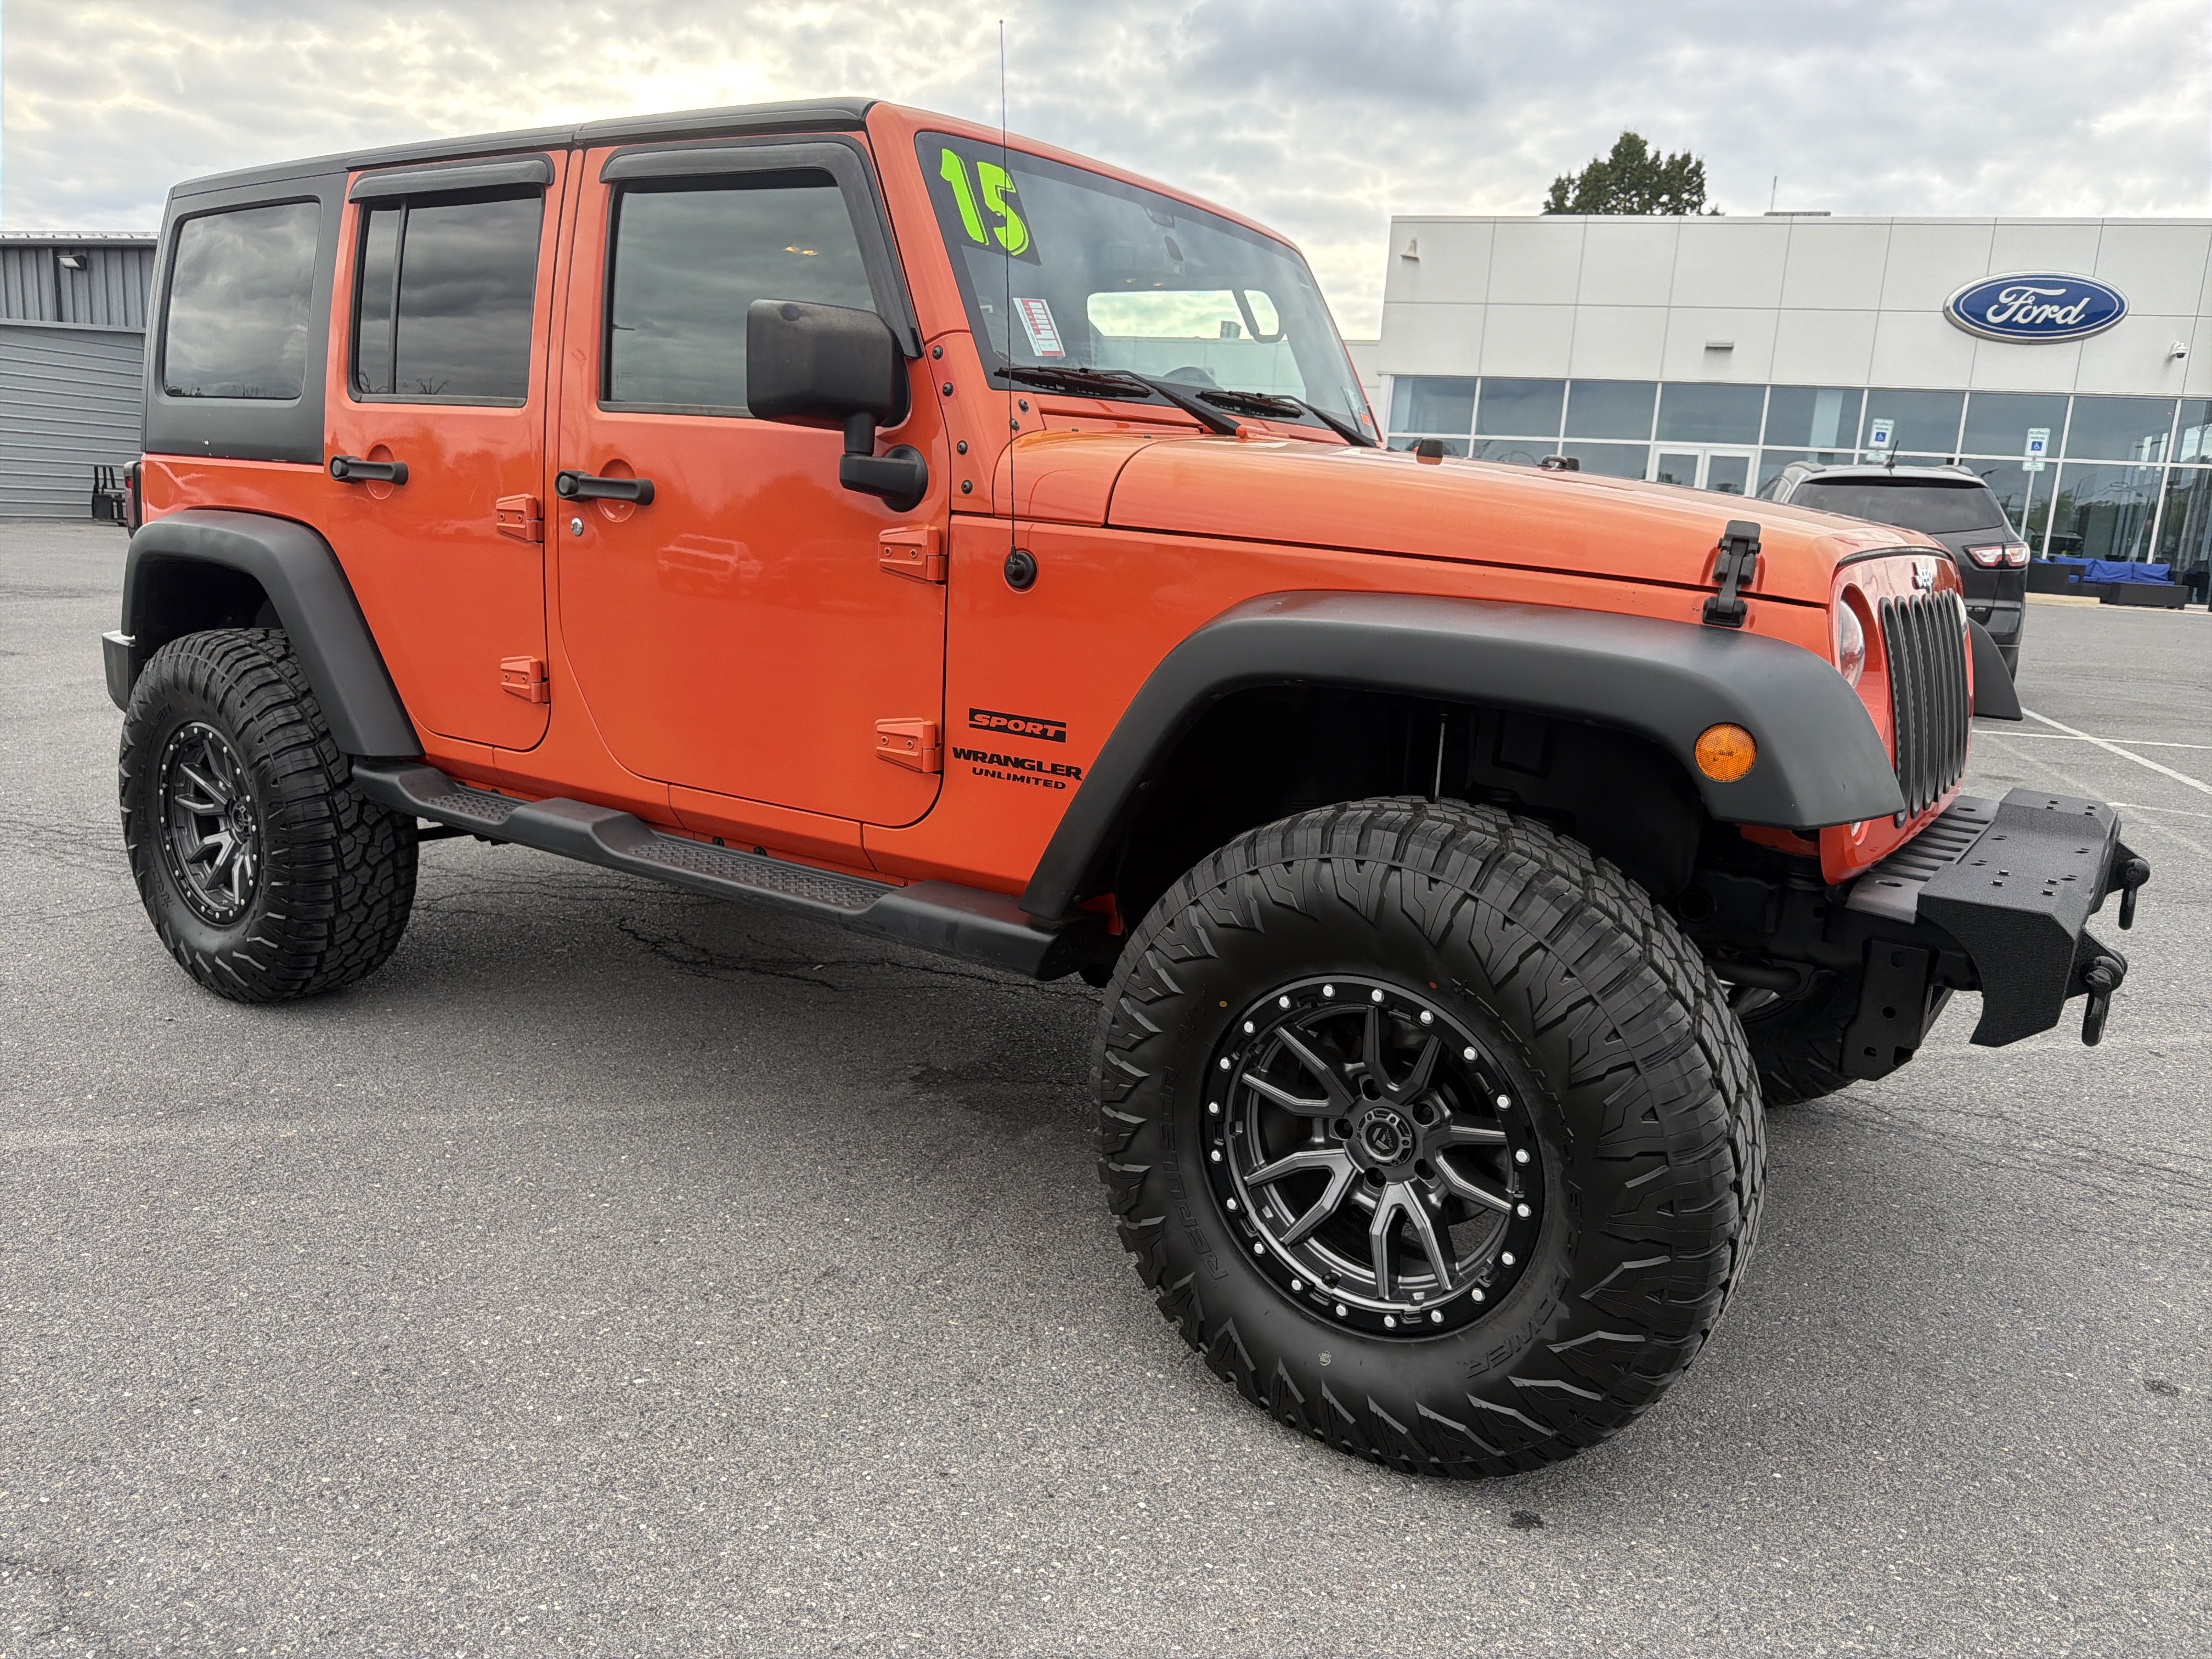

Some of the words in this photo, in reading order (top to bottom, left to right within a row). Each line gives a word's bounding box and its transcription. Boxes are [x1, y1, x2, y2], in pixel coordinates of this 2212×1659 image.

[940, 148, 1029, 256] 15
[1986, 286, 2091, 325] Ford
[1911, 562, 1933, 593] Jeep
[969, 713, 1065, 738] SPORT
[952, 747, 1082, 781] WRANGLER
[972, 767, 1066, 789] UNLIMITED
